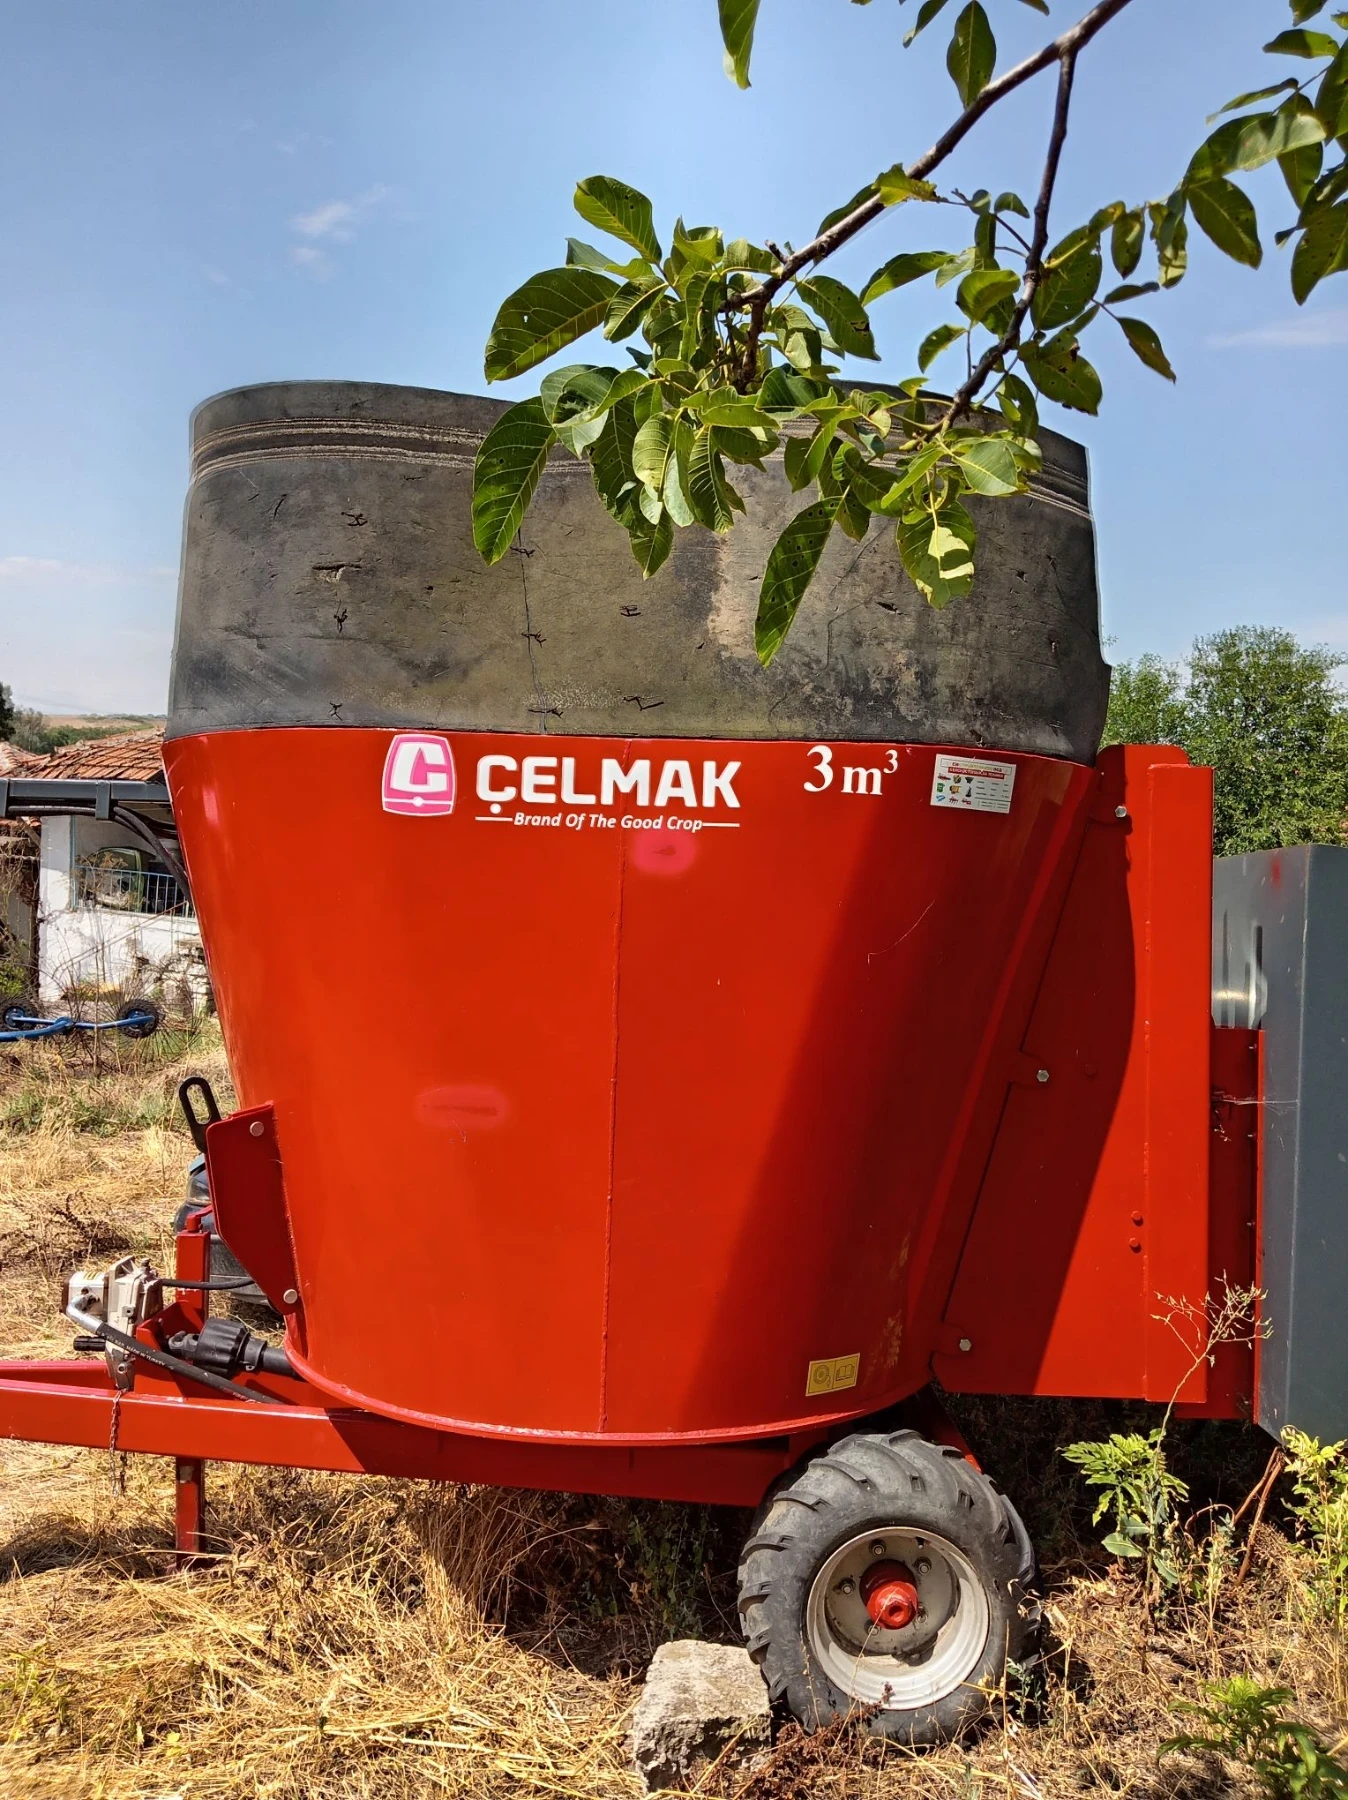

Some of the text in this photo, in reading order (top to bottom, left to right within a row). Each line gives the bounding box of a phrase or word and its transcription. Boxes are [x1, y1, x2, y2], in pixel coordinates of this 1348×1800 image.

[476, 754, 742, 814] ÇELMAK
[803, 744, 834, 792] 3
[513, 812, 702, 832] Brand Of The Good Crop
